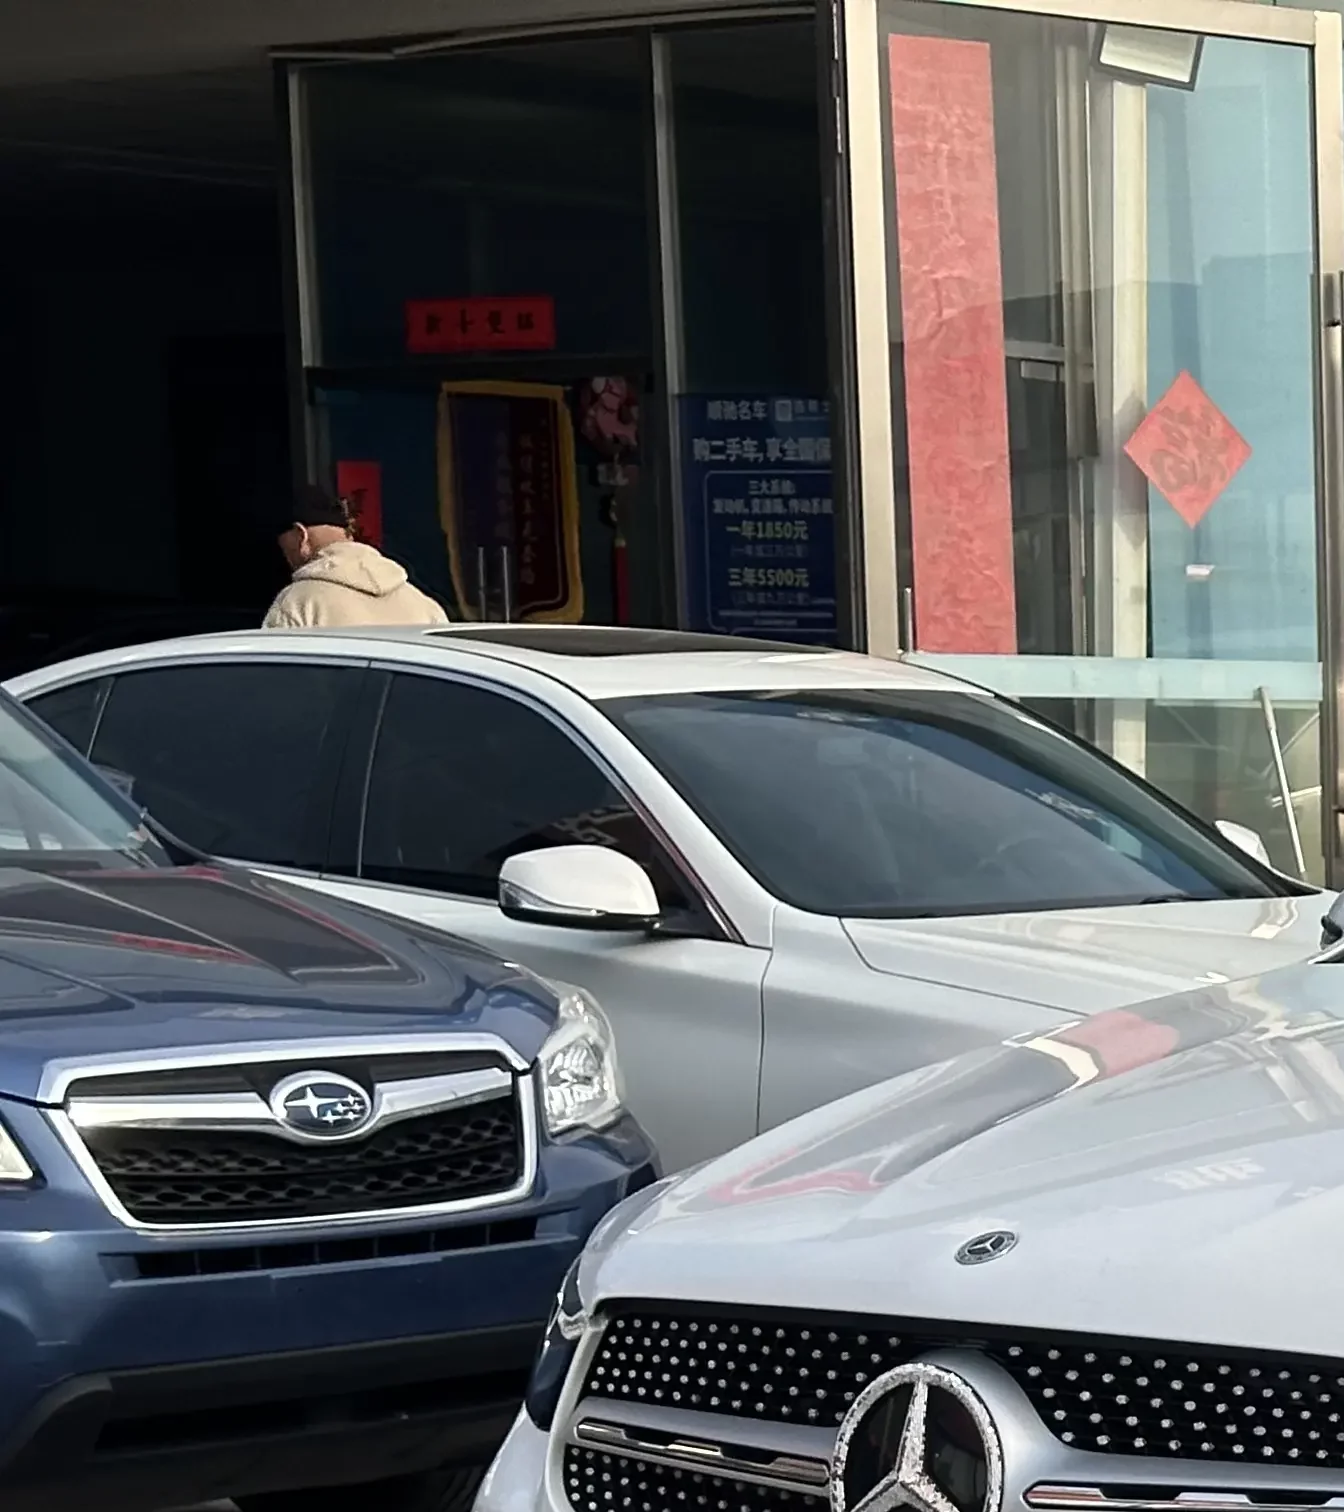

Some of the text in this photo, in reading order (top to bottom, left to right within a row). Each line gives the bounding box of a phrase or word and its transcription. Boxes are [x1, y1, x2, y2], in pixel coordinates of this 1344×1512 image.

[726, 520, 808, 541] 一年1850元
[728, 568, 809, 588] 三年5500元
